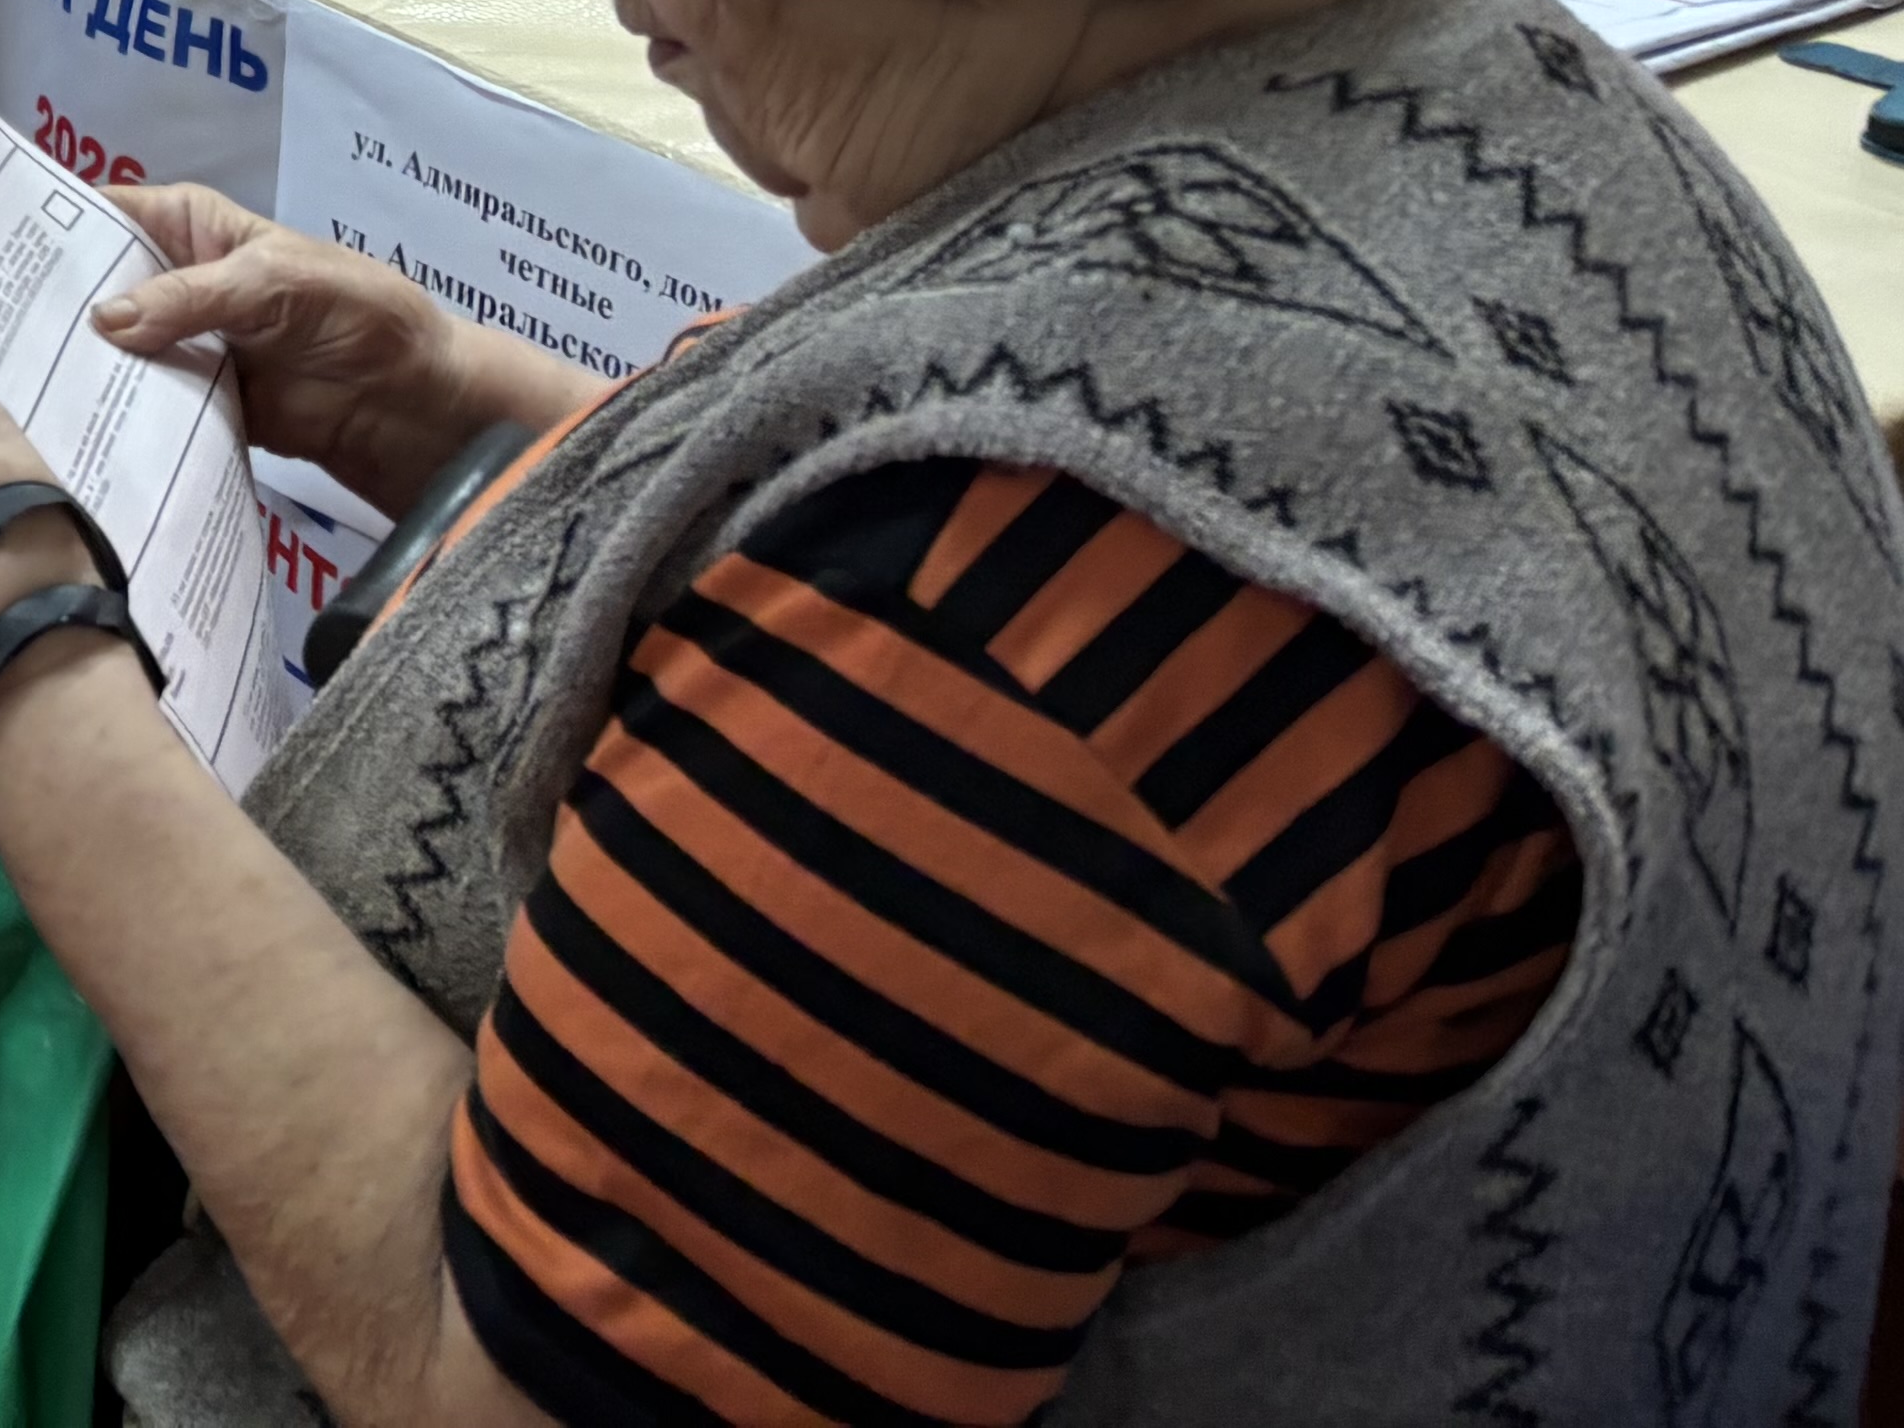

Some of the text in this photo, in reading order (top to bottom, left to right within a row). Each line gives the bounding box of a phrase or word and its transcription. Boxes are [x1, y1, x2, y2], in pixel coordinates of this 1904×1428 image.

[350, 131, 724, 314] ул. Адмиральского, дом
[499, 248, 615, 321] четные
